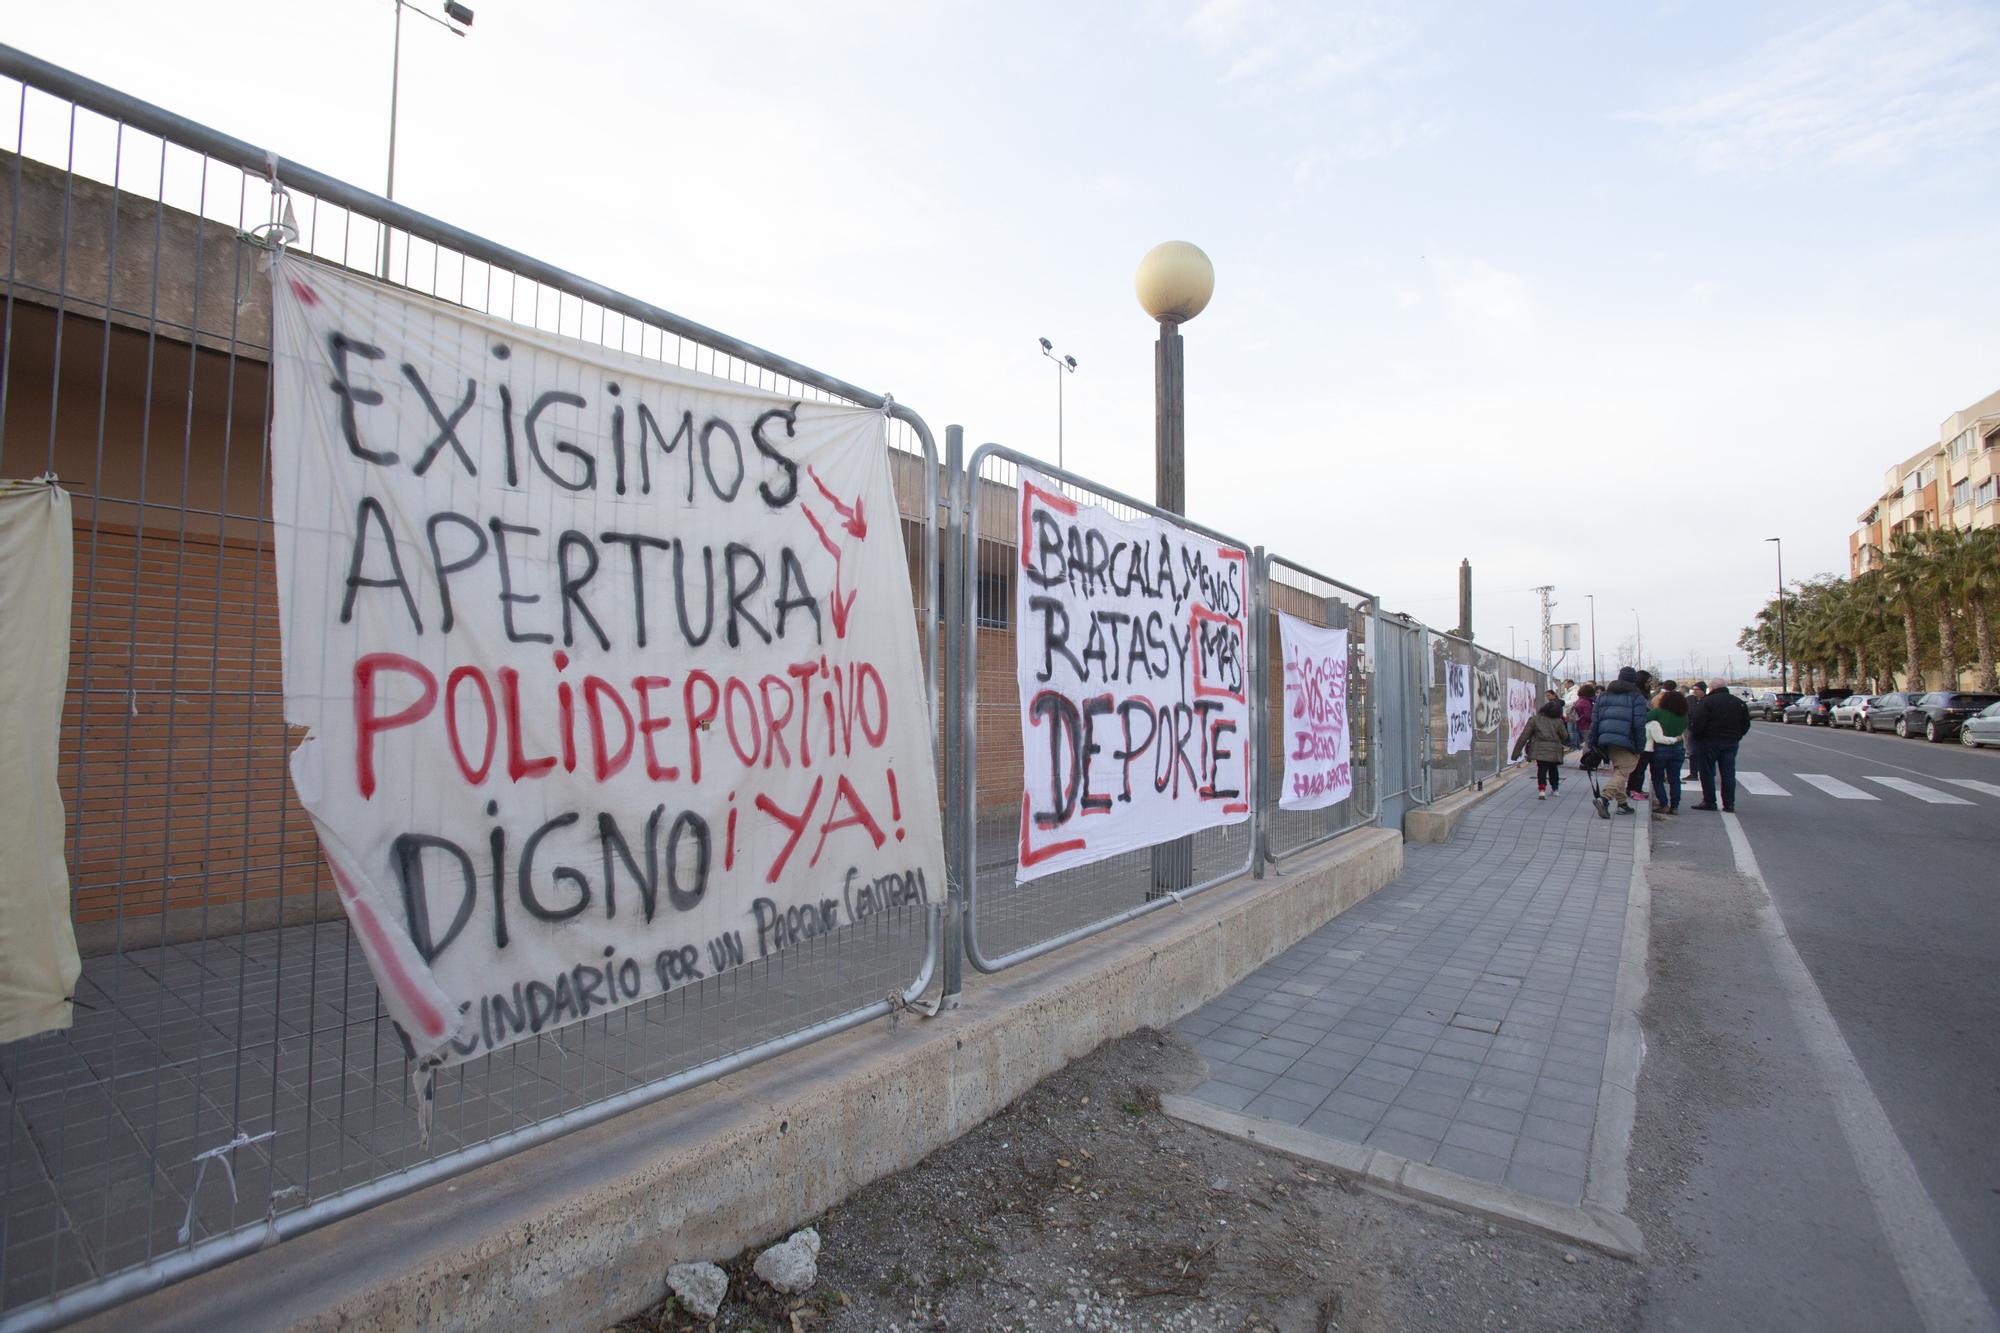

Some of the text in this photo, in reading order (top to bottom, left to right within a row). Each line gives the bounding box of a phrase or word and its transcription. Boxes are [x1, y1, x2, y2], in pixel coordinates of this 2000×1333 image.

[329, 331, 801, 508] EXIGIMOS
[340, 496, 822, 651] APERTURA
[1181, 545, 1241, 620] MENOS
[1029, 596, 1170, 684] RATAS
[1170, 622, 1192, 704] Y
[353, 650, 889, 799] POLIDEPORTIVO
[1030, 690, 1241, 830] DEPORTE
[390, 801, 712, 966] DIGNO
[393, 946, 641, 1060] CINDARIO
[656, 944, 704, 991] POR
[708, 930, 744, 973] UN
